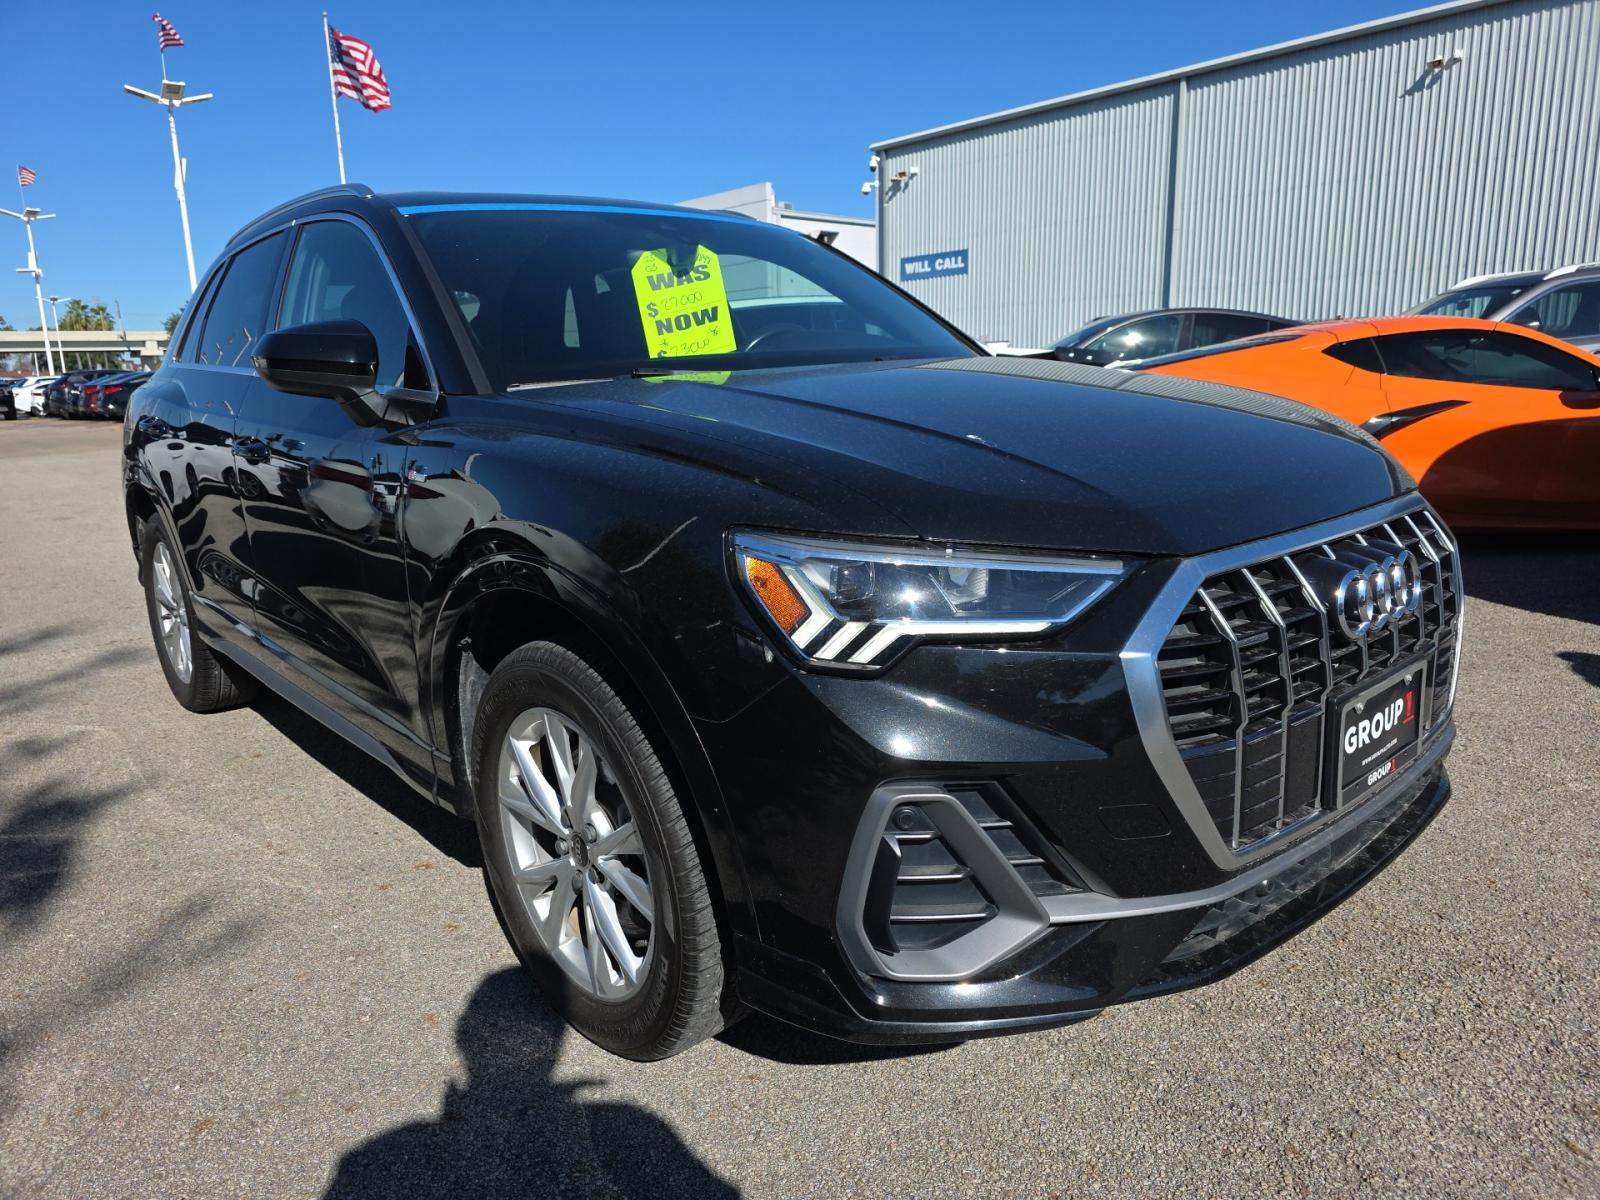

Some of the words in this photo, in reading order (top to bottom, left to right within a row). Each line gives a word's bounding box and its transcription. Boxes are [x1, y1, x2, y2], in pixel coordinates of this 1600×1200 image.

[904, 260, 931, 275] WILL
[934, 256, 965, 271] CALL
[655, 306, 719, 336] NOW
